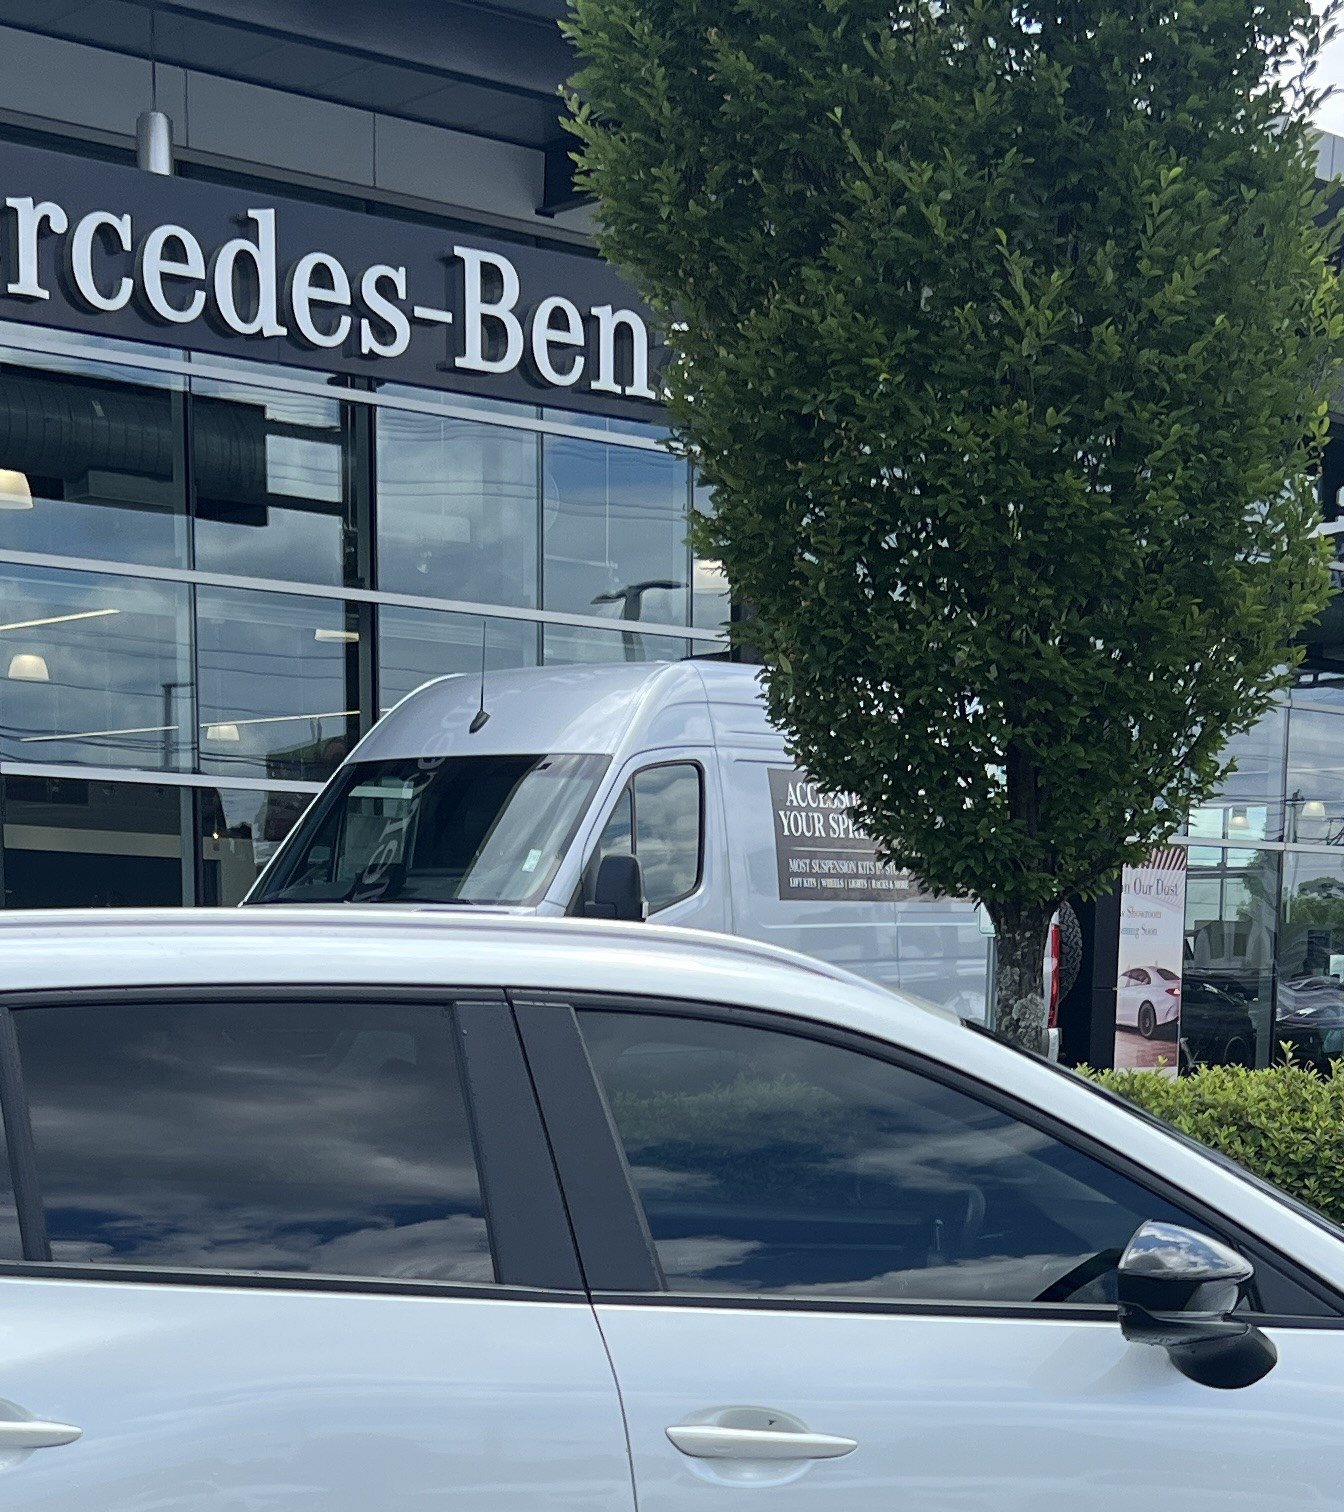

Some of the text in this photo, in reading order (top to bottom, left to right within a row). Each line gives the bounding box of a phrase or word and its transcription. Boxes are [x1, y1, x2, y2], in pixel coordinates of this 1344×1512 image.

[778, 811, 826, 837] YOUR
[789, 859, 810, 873] MOST
[811, 860, 857, 874] SUSPENSION
[858, 861, 875, 874] KITS
[820, 878, 844, 889] WHEELS
[1133, 878, 1153, 896] Our
[1156, 879, 1178, 896] Dust
